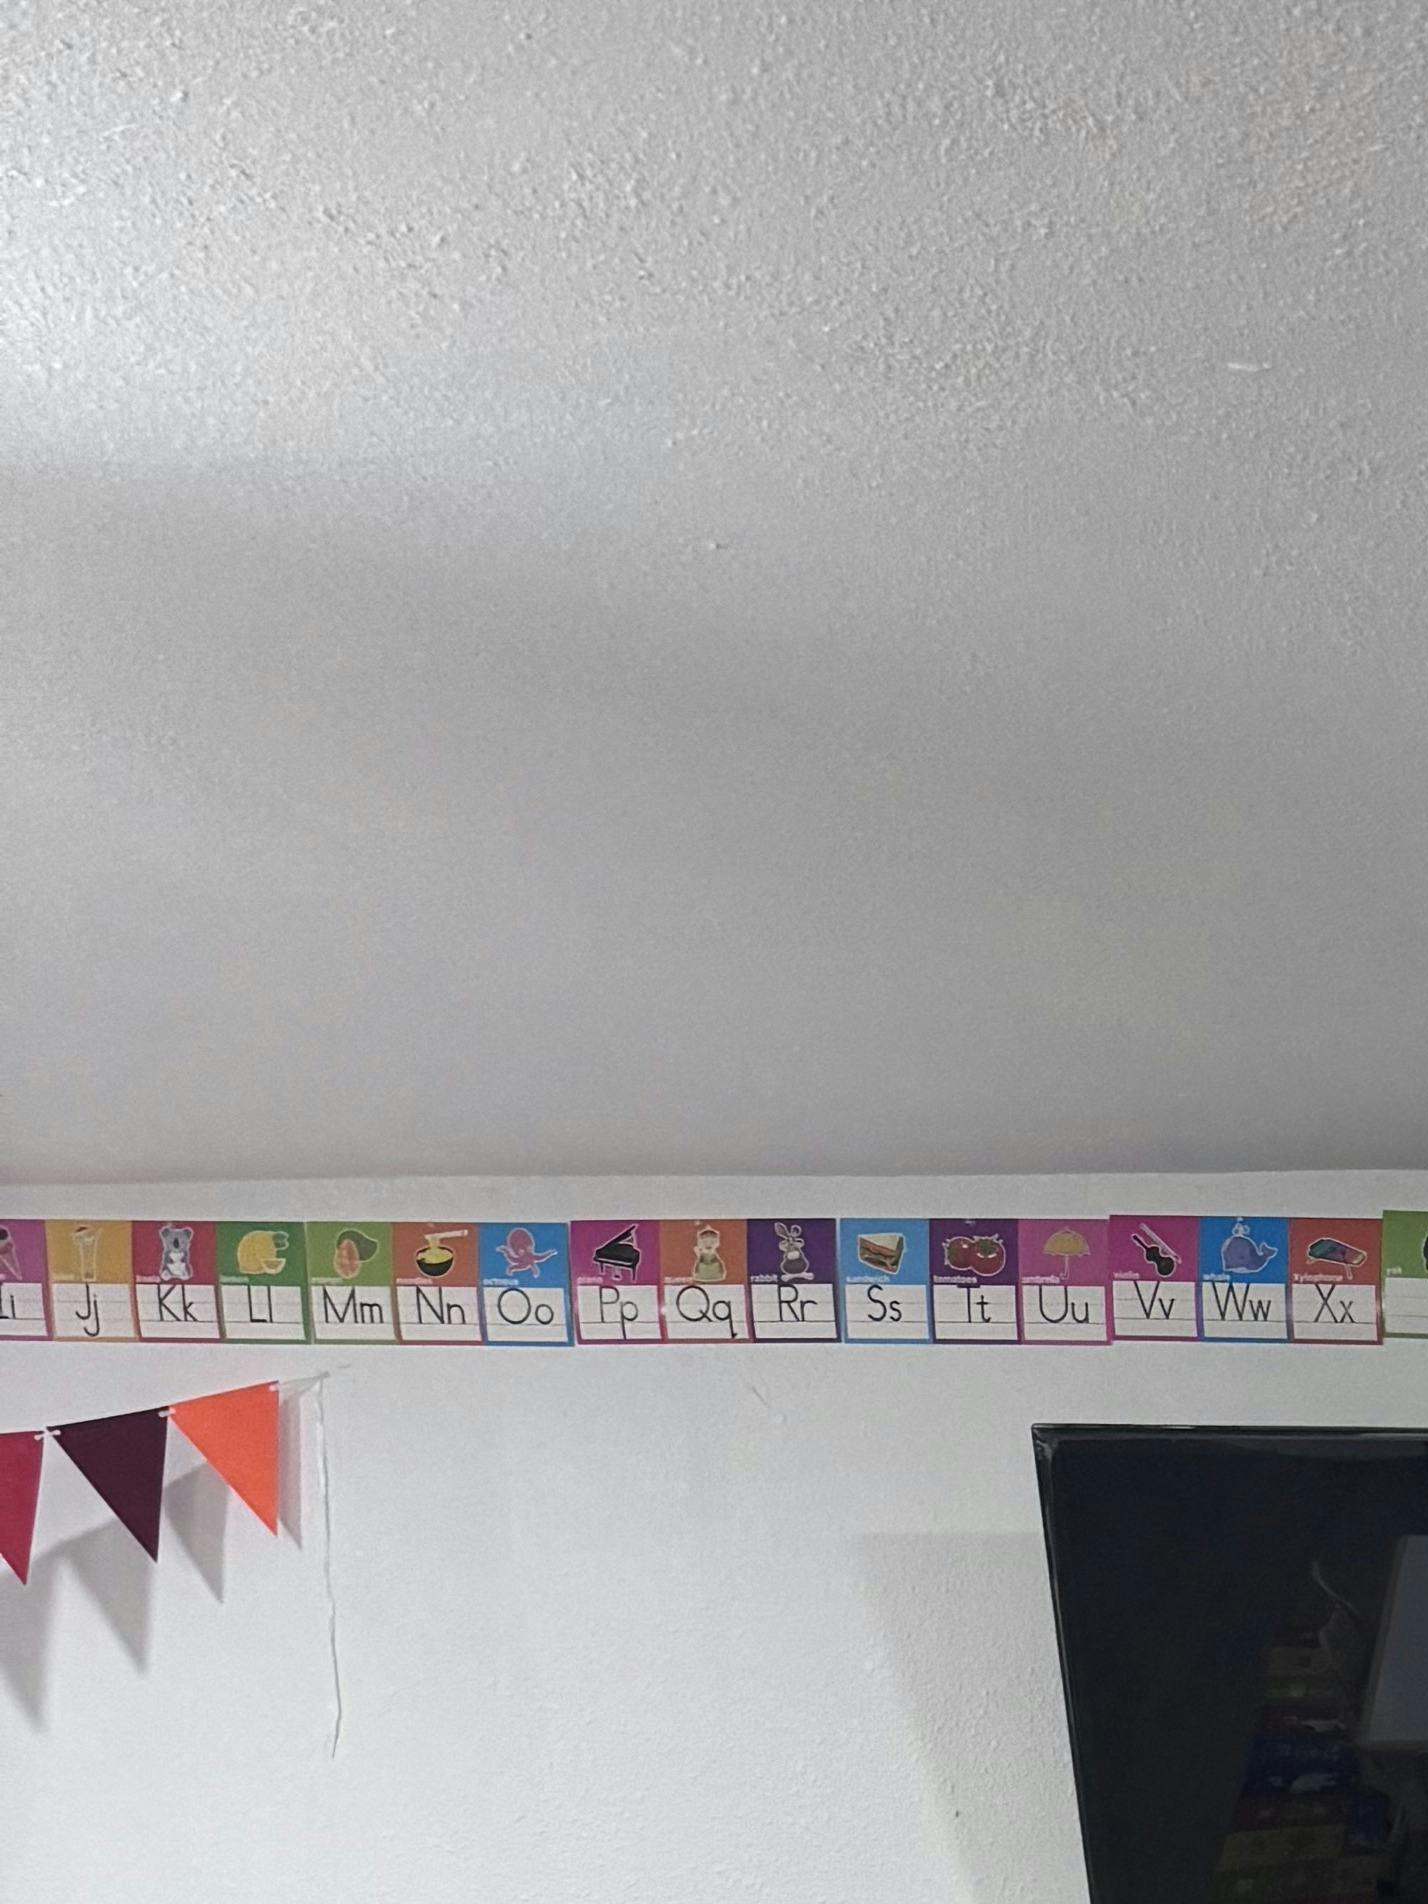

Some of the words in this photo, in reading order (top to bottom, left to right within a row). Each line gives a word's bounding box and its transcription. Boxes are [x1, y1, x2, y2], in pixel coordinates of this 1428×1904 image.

[75, 1282, 100, 1337] Jj
[157, 1283, 198, 1322] Kk
[247, 1284, 273, 1323] Ll
[322, 1285, 384, 1324] Mm
[415, 1285, 466, 1324] Nn
[497, 1287, 554, 1325] Oo
[599, 1285, 639, 1340] Pp
[676, 1285, 738, 1339] Qq
[777, 1284, 818, 1322] Rr
[867, 1284, 902, 1322] Ss
[957, 1284, 991, 1323] Tt
[1038, 1285, 1090, 1324] Uu
[1133, 1280, 1175, 1320] Vv
[1212, 1282, 1272, 1321] Ww
[1314, 1284, 1356, 1323] Xx
